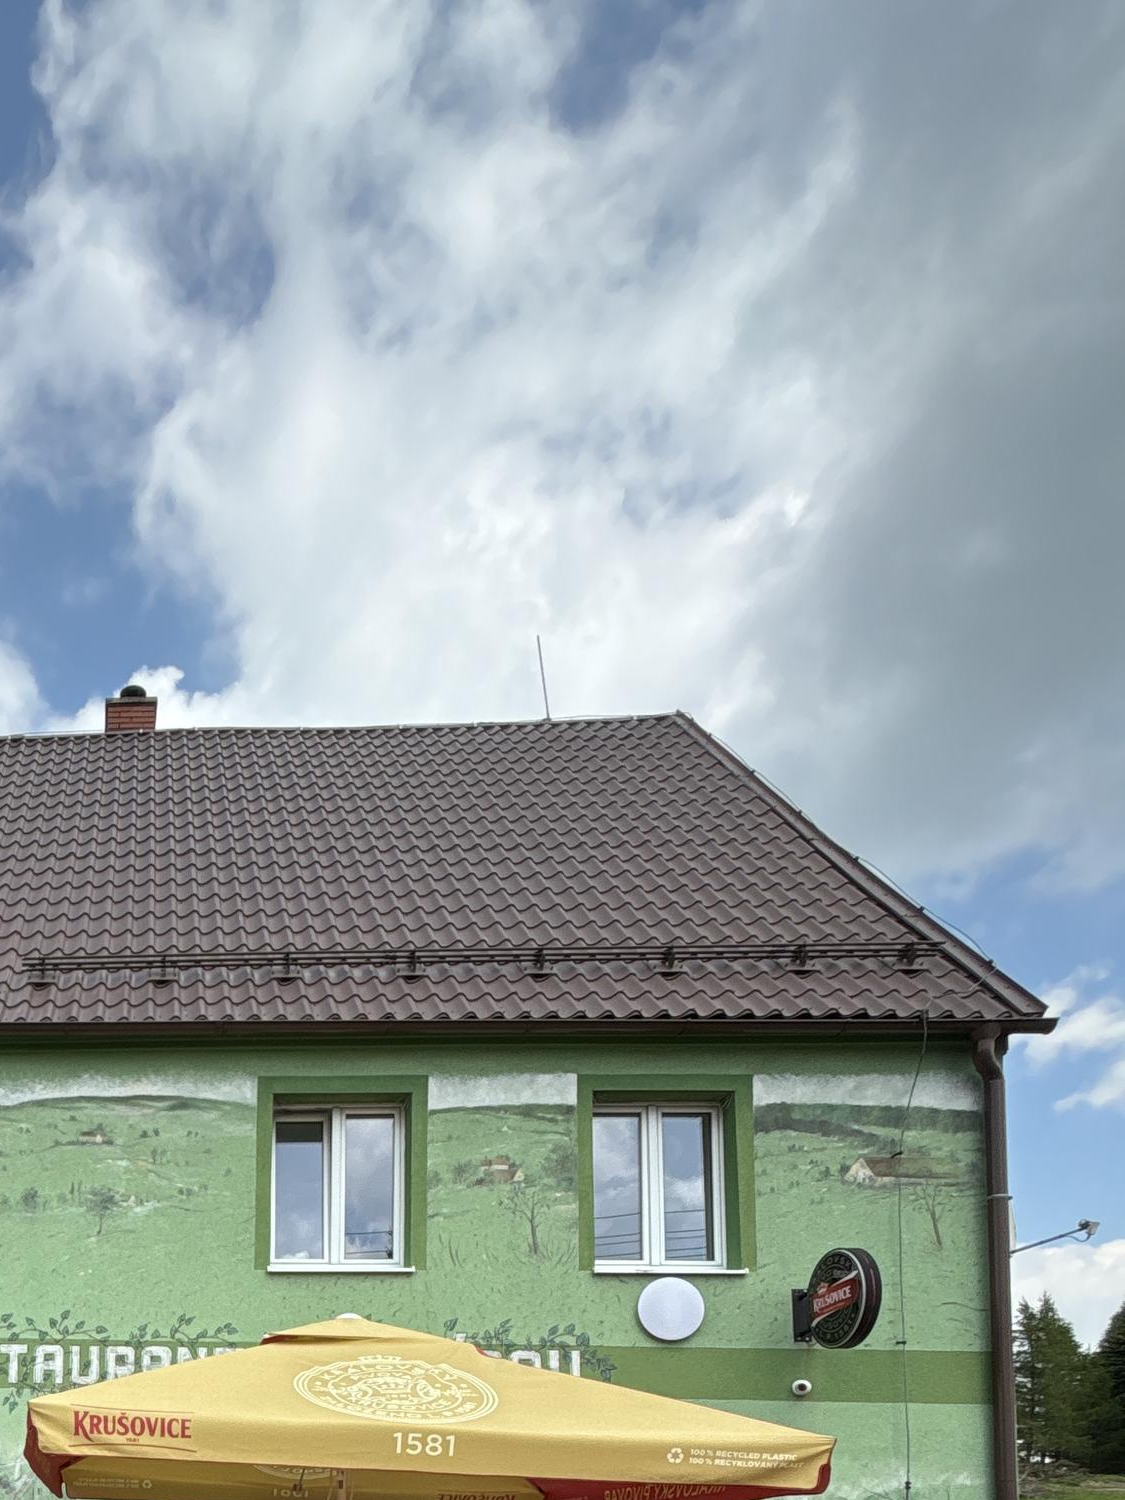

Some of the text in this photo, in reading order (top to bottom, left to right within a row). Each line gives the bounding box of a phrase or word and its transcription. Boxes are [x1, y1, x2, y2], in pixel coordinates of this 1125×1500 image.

[73, 1411, 192, 1442] KRUŠOVICE
[393, 1432, 456, 1457] 1581
[715, 1450, 760, 1460] RECYCLED
[761, 1453, 798, 1461] PLASTIC
